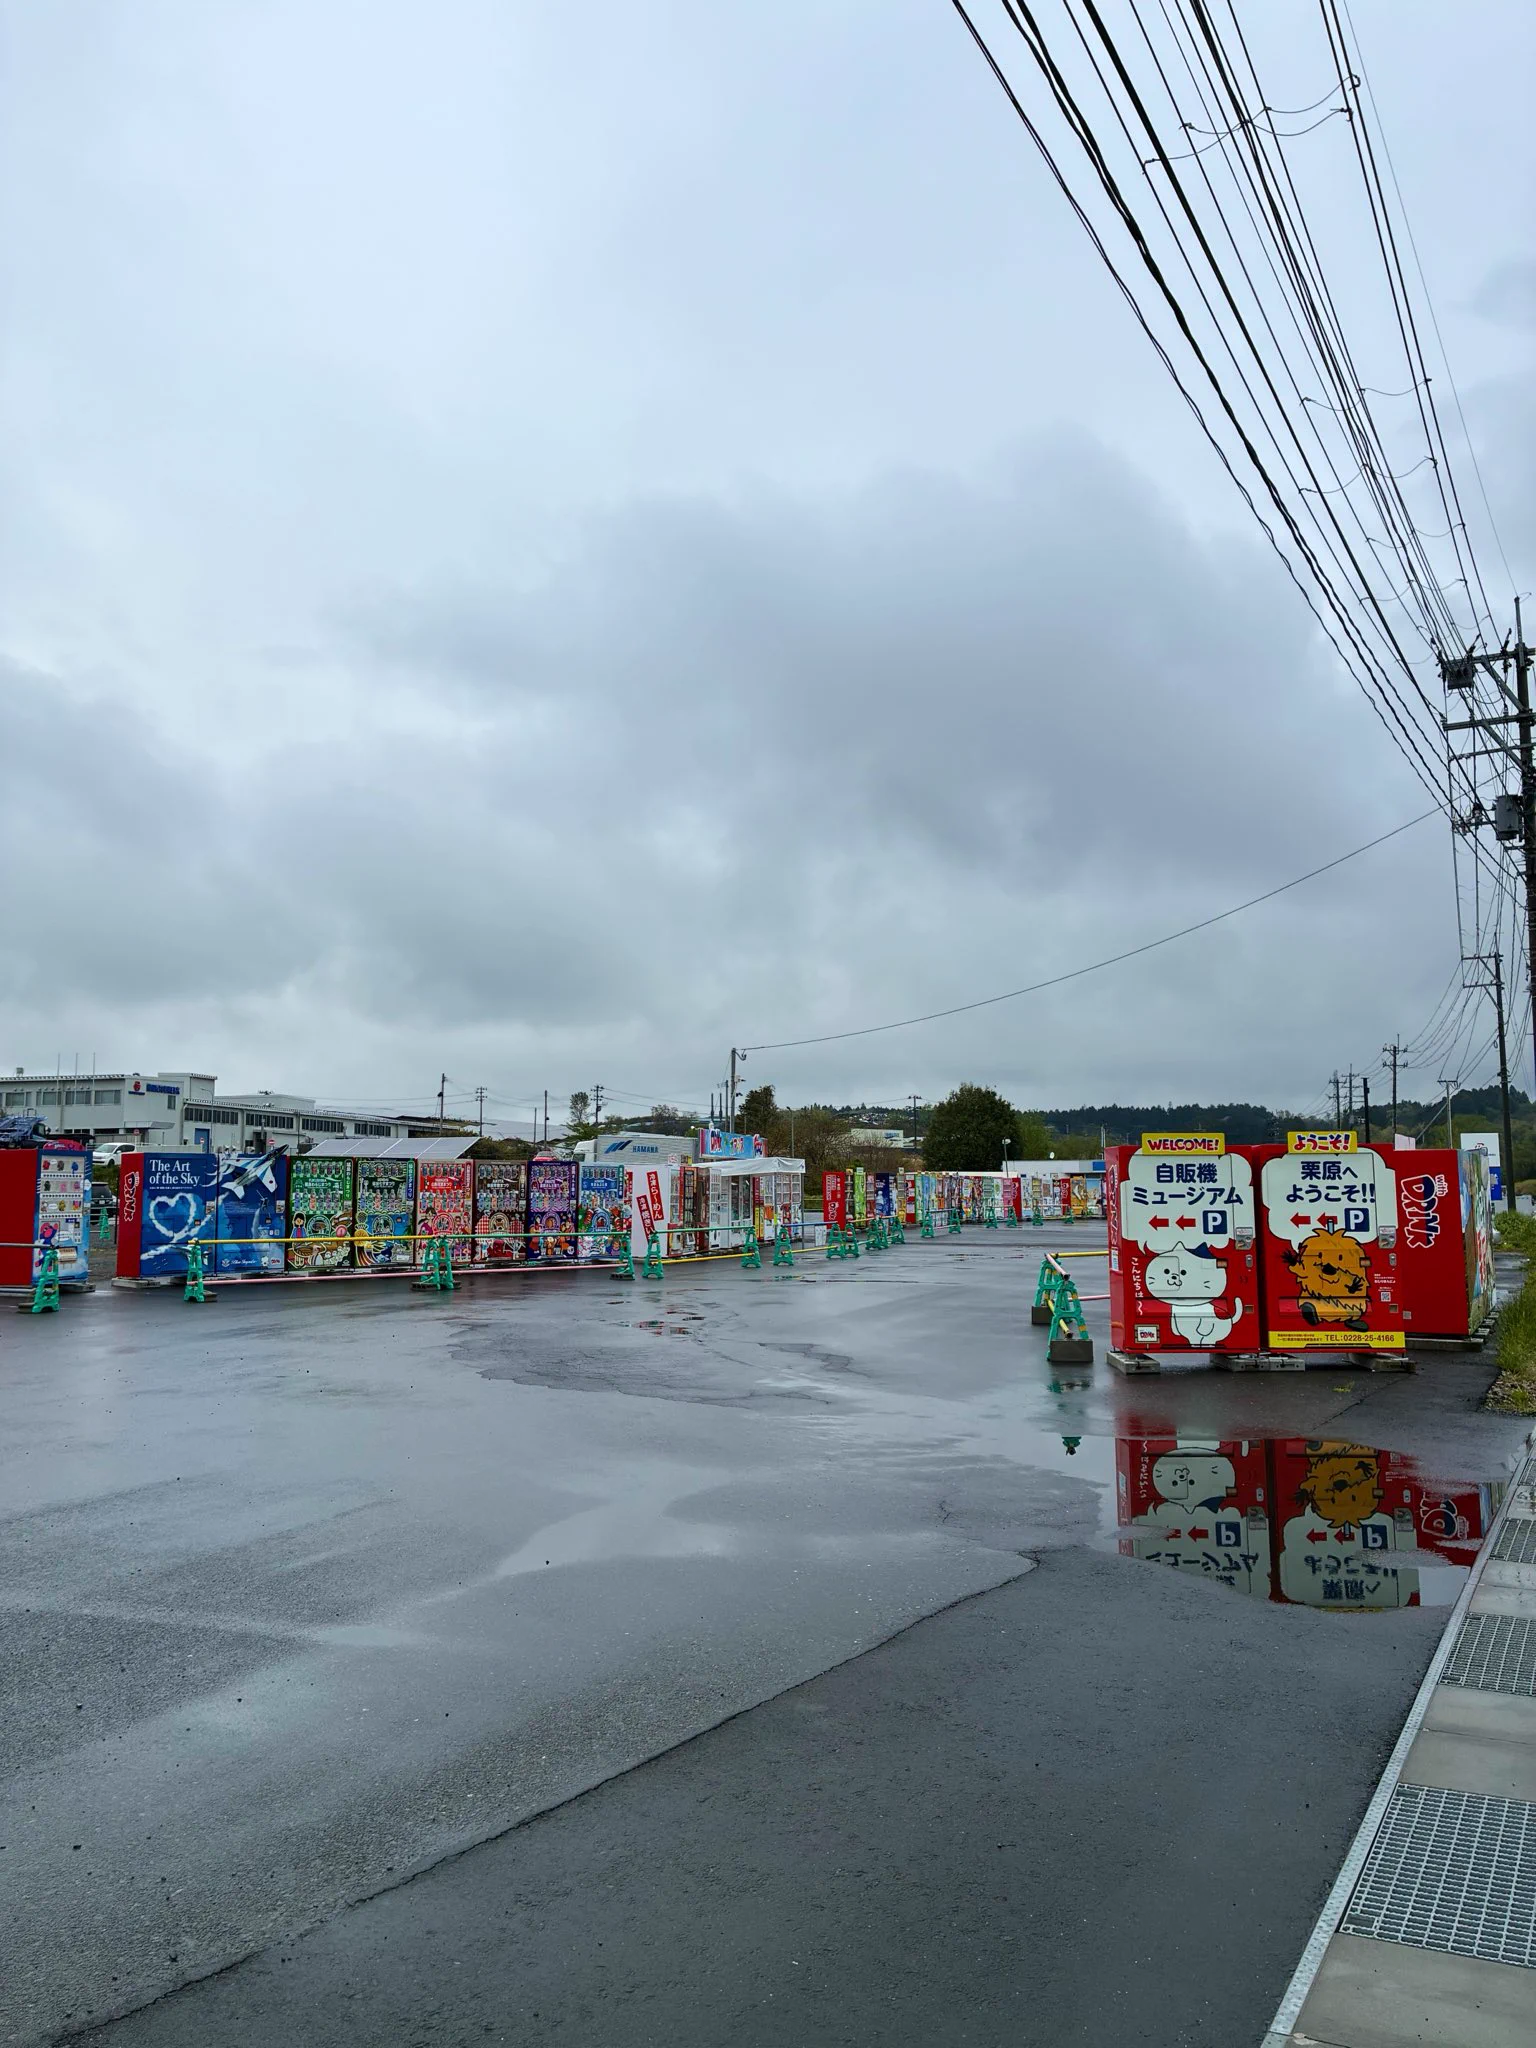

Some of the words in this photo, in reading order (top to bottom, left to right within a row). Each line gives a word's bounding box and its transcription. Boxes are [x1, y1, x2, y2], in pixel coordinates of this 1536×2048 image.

[1147, 1138, 1219, 1151] WELCOME!
[1294, 1134, 1350, 1151] ようこそ!
[149, 1159, 170, 1172] The
[172, 1159, 190, 1172] Art
[1156, 1163, 1218, 1183] 自販機
[1301, 1161, 1358, 1180] 栗原へ
[149, 1172, 161, 1184] of
[162, 1172, 179, 1184] the
[180, 1172, 200, 1187] Sky
[1435, 1174, 1448, 1197] with
[1132, 1187, 1243, 1205] ミュージアム
[1286, 1183, 1375, 1203] ようこそ!!
[1349, 1210, 1364, 1230] P
[1401, 1174, 1440, 1248] DRINK
[1208, 1213, 1222, 1232] P
